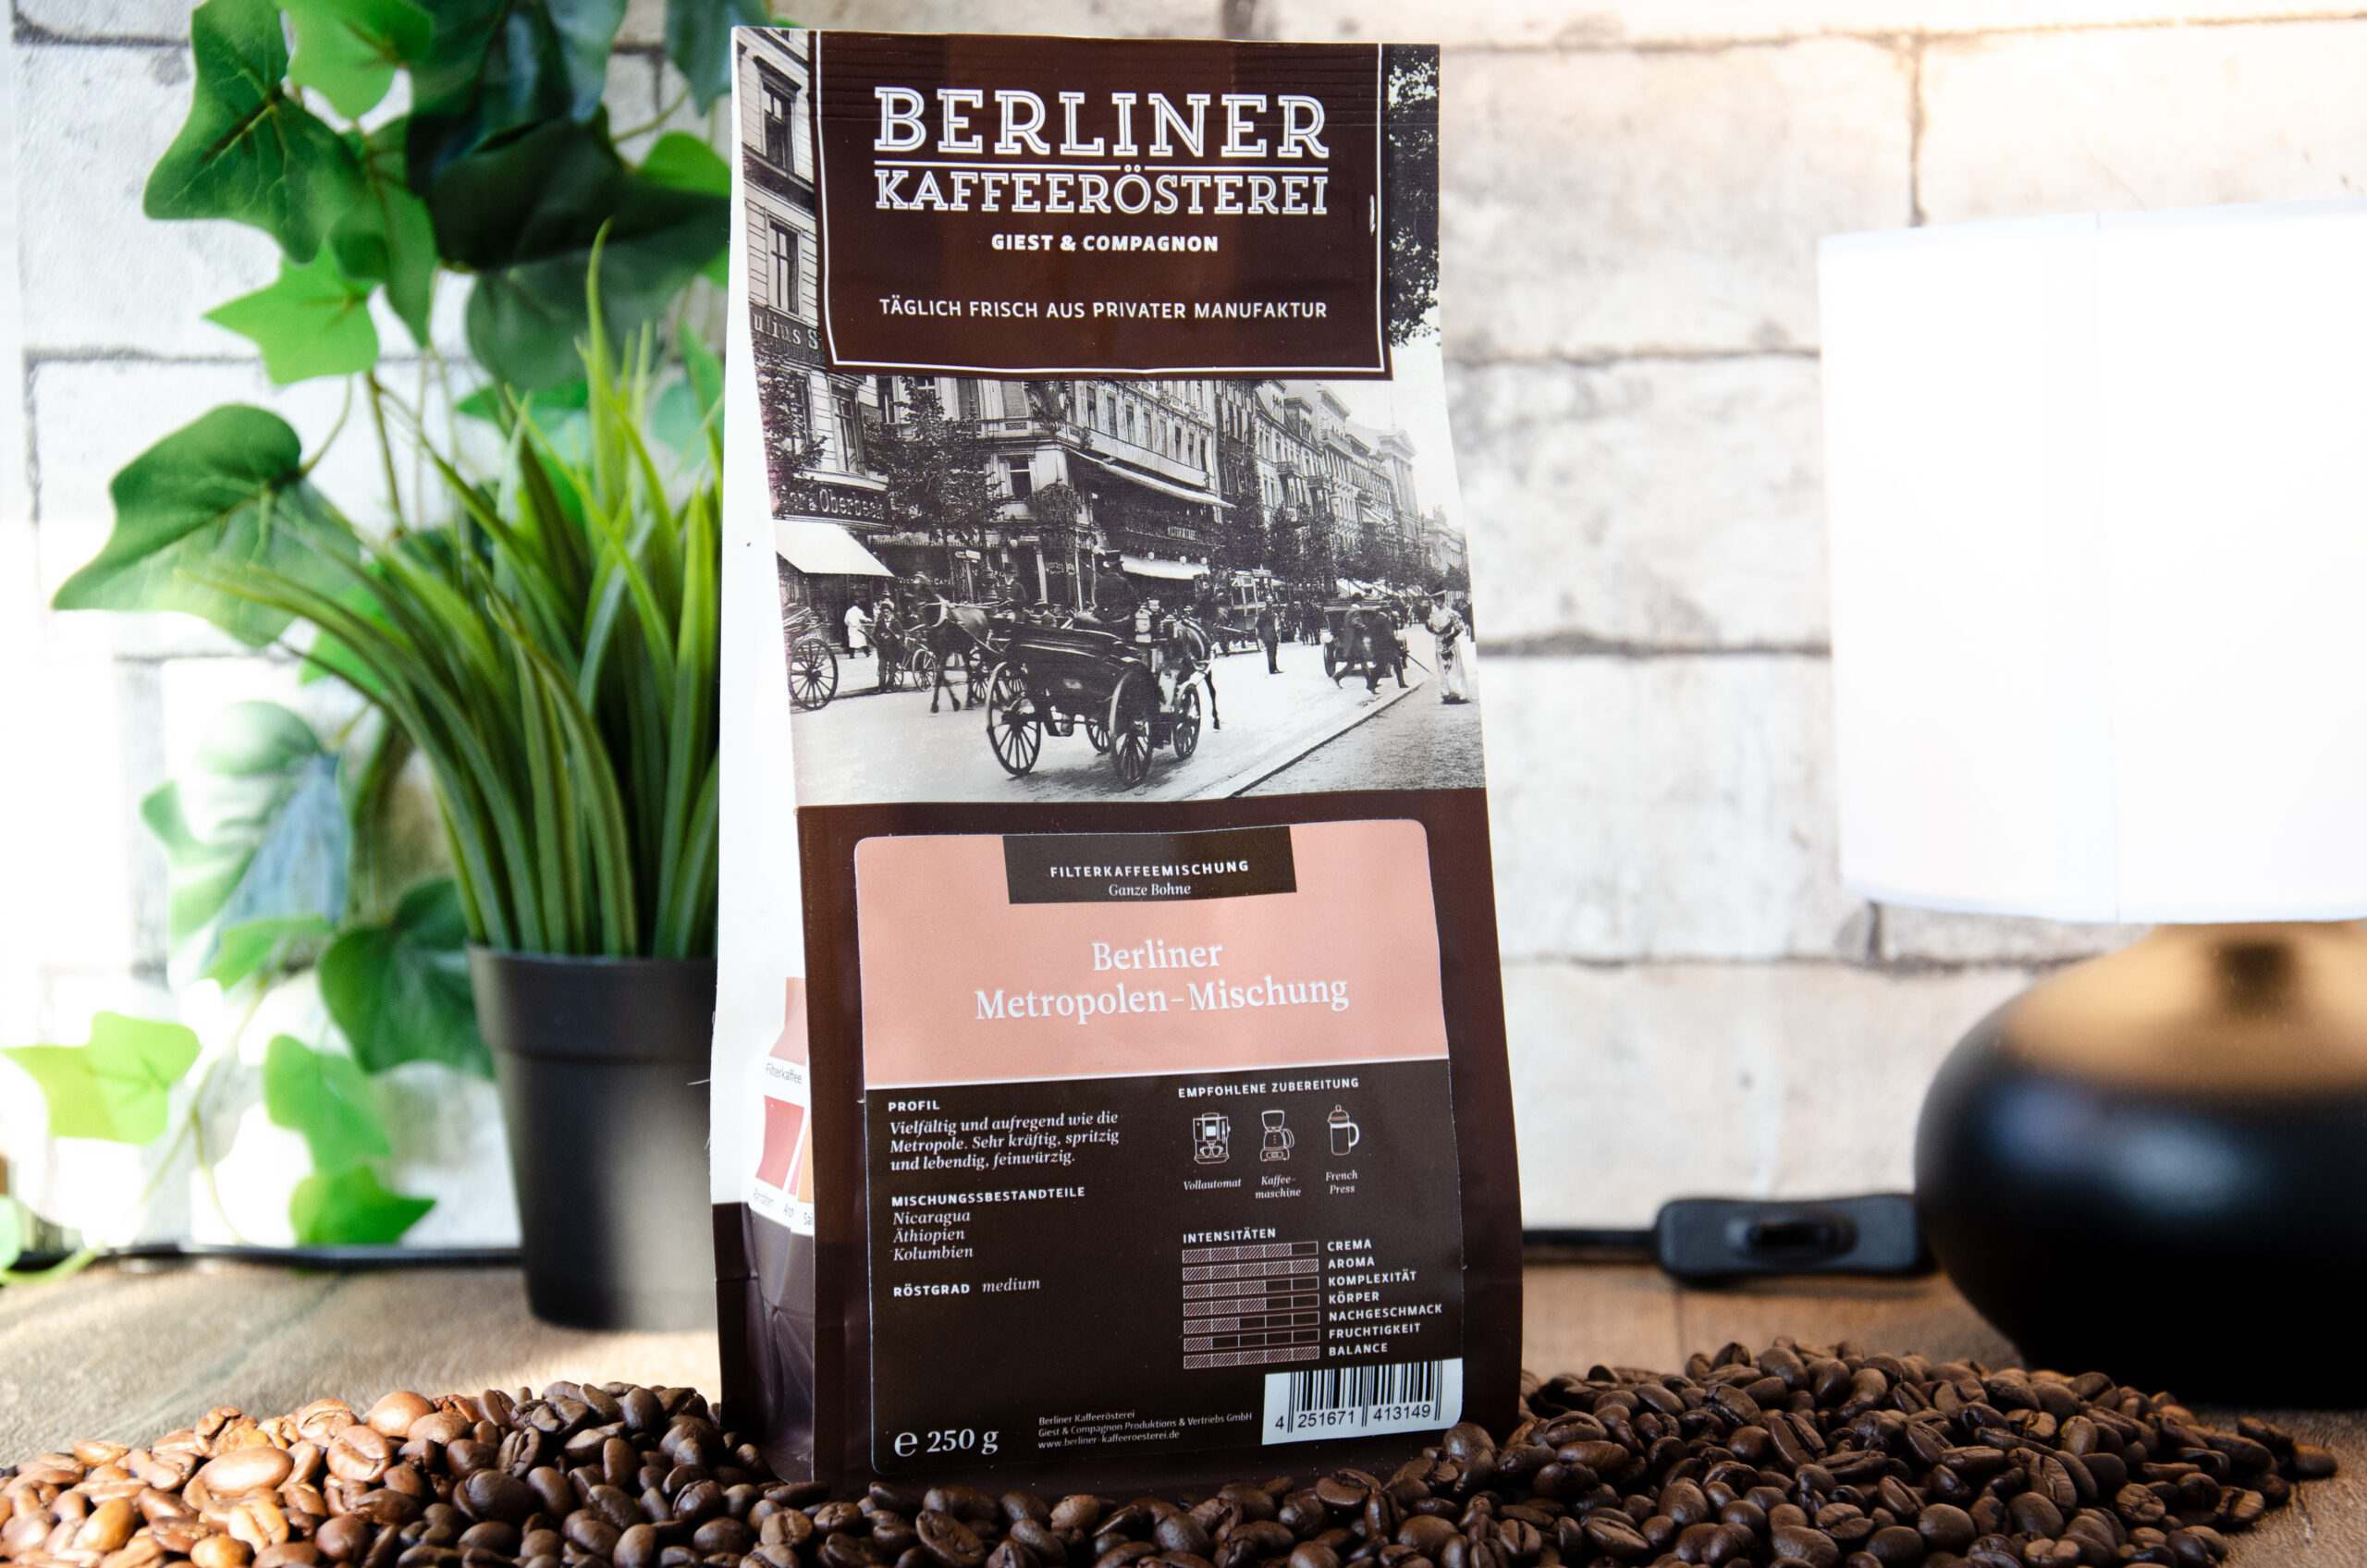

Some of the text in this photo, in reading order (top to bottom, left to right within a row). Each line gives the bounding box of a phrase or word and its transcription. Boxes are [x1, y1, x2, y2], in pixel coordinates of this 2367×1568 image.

[874, 86, 1329, 159] BERLINER
[874, 164, 1328, 216] KAFFEERÖSTEREI
[991, 233, 1219, 252] GIEST & COMPAGNON
[879, 295, 1328, 319] TÄGLICH FRISCH AUS PRIVATER MANUFAKTUR
[1050, 861, 1249, 878] FILTERKAFFEEMISCHUNG
[1109, 881, 1191, 897] Ganze Bohne
[1091, 939, 1222, 972] Berliner
[975, 975, 1349, 1024] Metropolen-Mischung
[766, 1062, 802, 1084] Filterkaffee
[1178, 1078, 1359, 1097] EMPFOHLENE ZUBEREITUNG
[889, 1100, 940, 1112] PROFIL
[890, 1111, 1118, 1136] Vielfältig und aufregend wie die
[890, 1129, 1120, 1156] Metropole. Sehr kräftig, spritzig
[890, 1150, 1075, 1170] und lebendig, feinwürzig.
[1184, 1178, 1242, 1191] Vollautomat
[1260, 1175, 1296, 1186] Kaffee-
[1325, 1170, 1358, 1182] French
[891, 1187, 1085, 1207] MISCHUNGSSBESTANDTEILE
[1255, 1187, 1302, 1199] maschine
[1330, 1183, 1355, 1194] Press
[893, 1210, 971, 1227] Nicaragua
[893, 1229, 965, 1244] Äthiopien
[1183, 1227, 1276, 1243] INTENSITÄTEN
[893, 1246, 974, 1261] Kolumbien
[1327, 1239, 1372, 1252] CREMA
[1328, 1256, 1375, 1269] AROMA
[1329, 1269, 1417, 1287] KOMPLEXITÄT
[893, 1278, 1041, 1297] RÖSTGRAD medium
[1329, 1291, 1380, 1305] KÖRPER
[1329, 1304, 1442, 1321] NACHGESCHMACK
[1329, 1323, 1421, 1339] FRUCHTIGKEIT
[1329, 1342, 1388, 1356] BALANCE
[1038, 1409, 1135, 1426] Berliner Kaffeerösterei
[1038, 1412, 1253, 1438] Giest & Compagnon Produktions & Vertriebs GmbH
[1275, 1404, 1431, 1429] 4 251671 413149
[926, 1428, 975, 1452] 250
[981, 1431, 999, 1455] g
[1037, 1430, 1180, 1449] www.berliner-kaffeeroesterei.de
